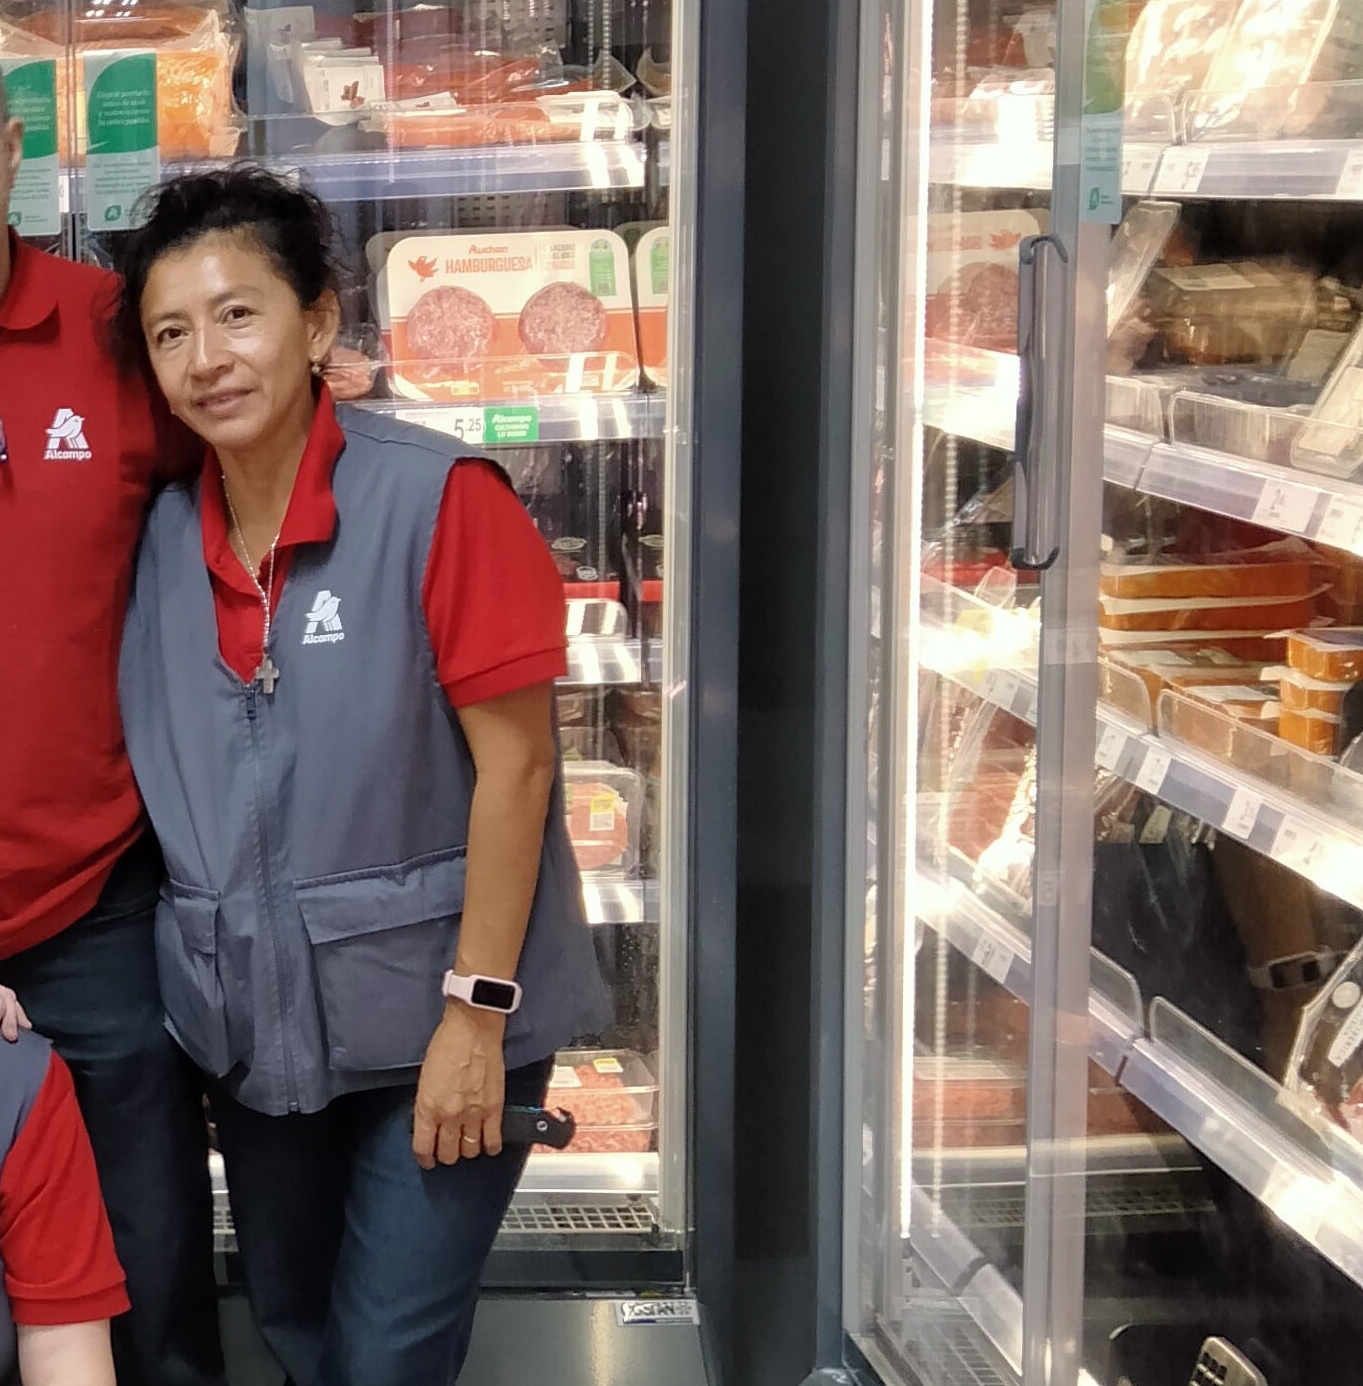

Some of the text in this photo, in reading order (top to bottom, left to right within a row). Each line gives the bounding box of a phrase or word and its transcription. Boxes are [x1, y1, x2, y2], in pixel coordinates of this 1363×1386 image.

[468, 244, 508, 255] Auchan
[445, 256, 533, 274] HAMBURGUESA
[492, 413, 532, 424] Alcampo
[43, 449, 92, 461] Alcampo
[301, 631, 345, 645] Alcampo
